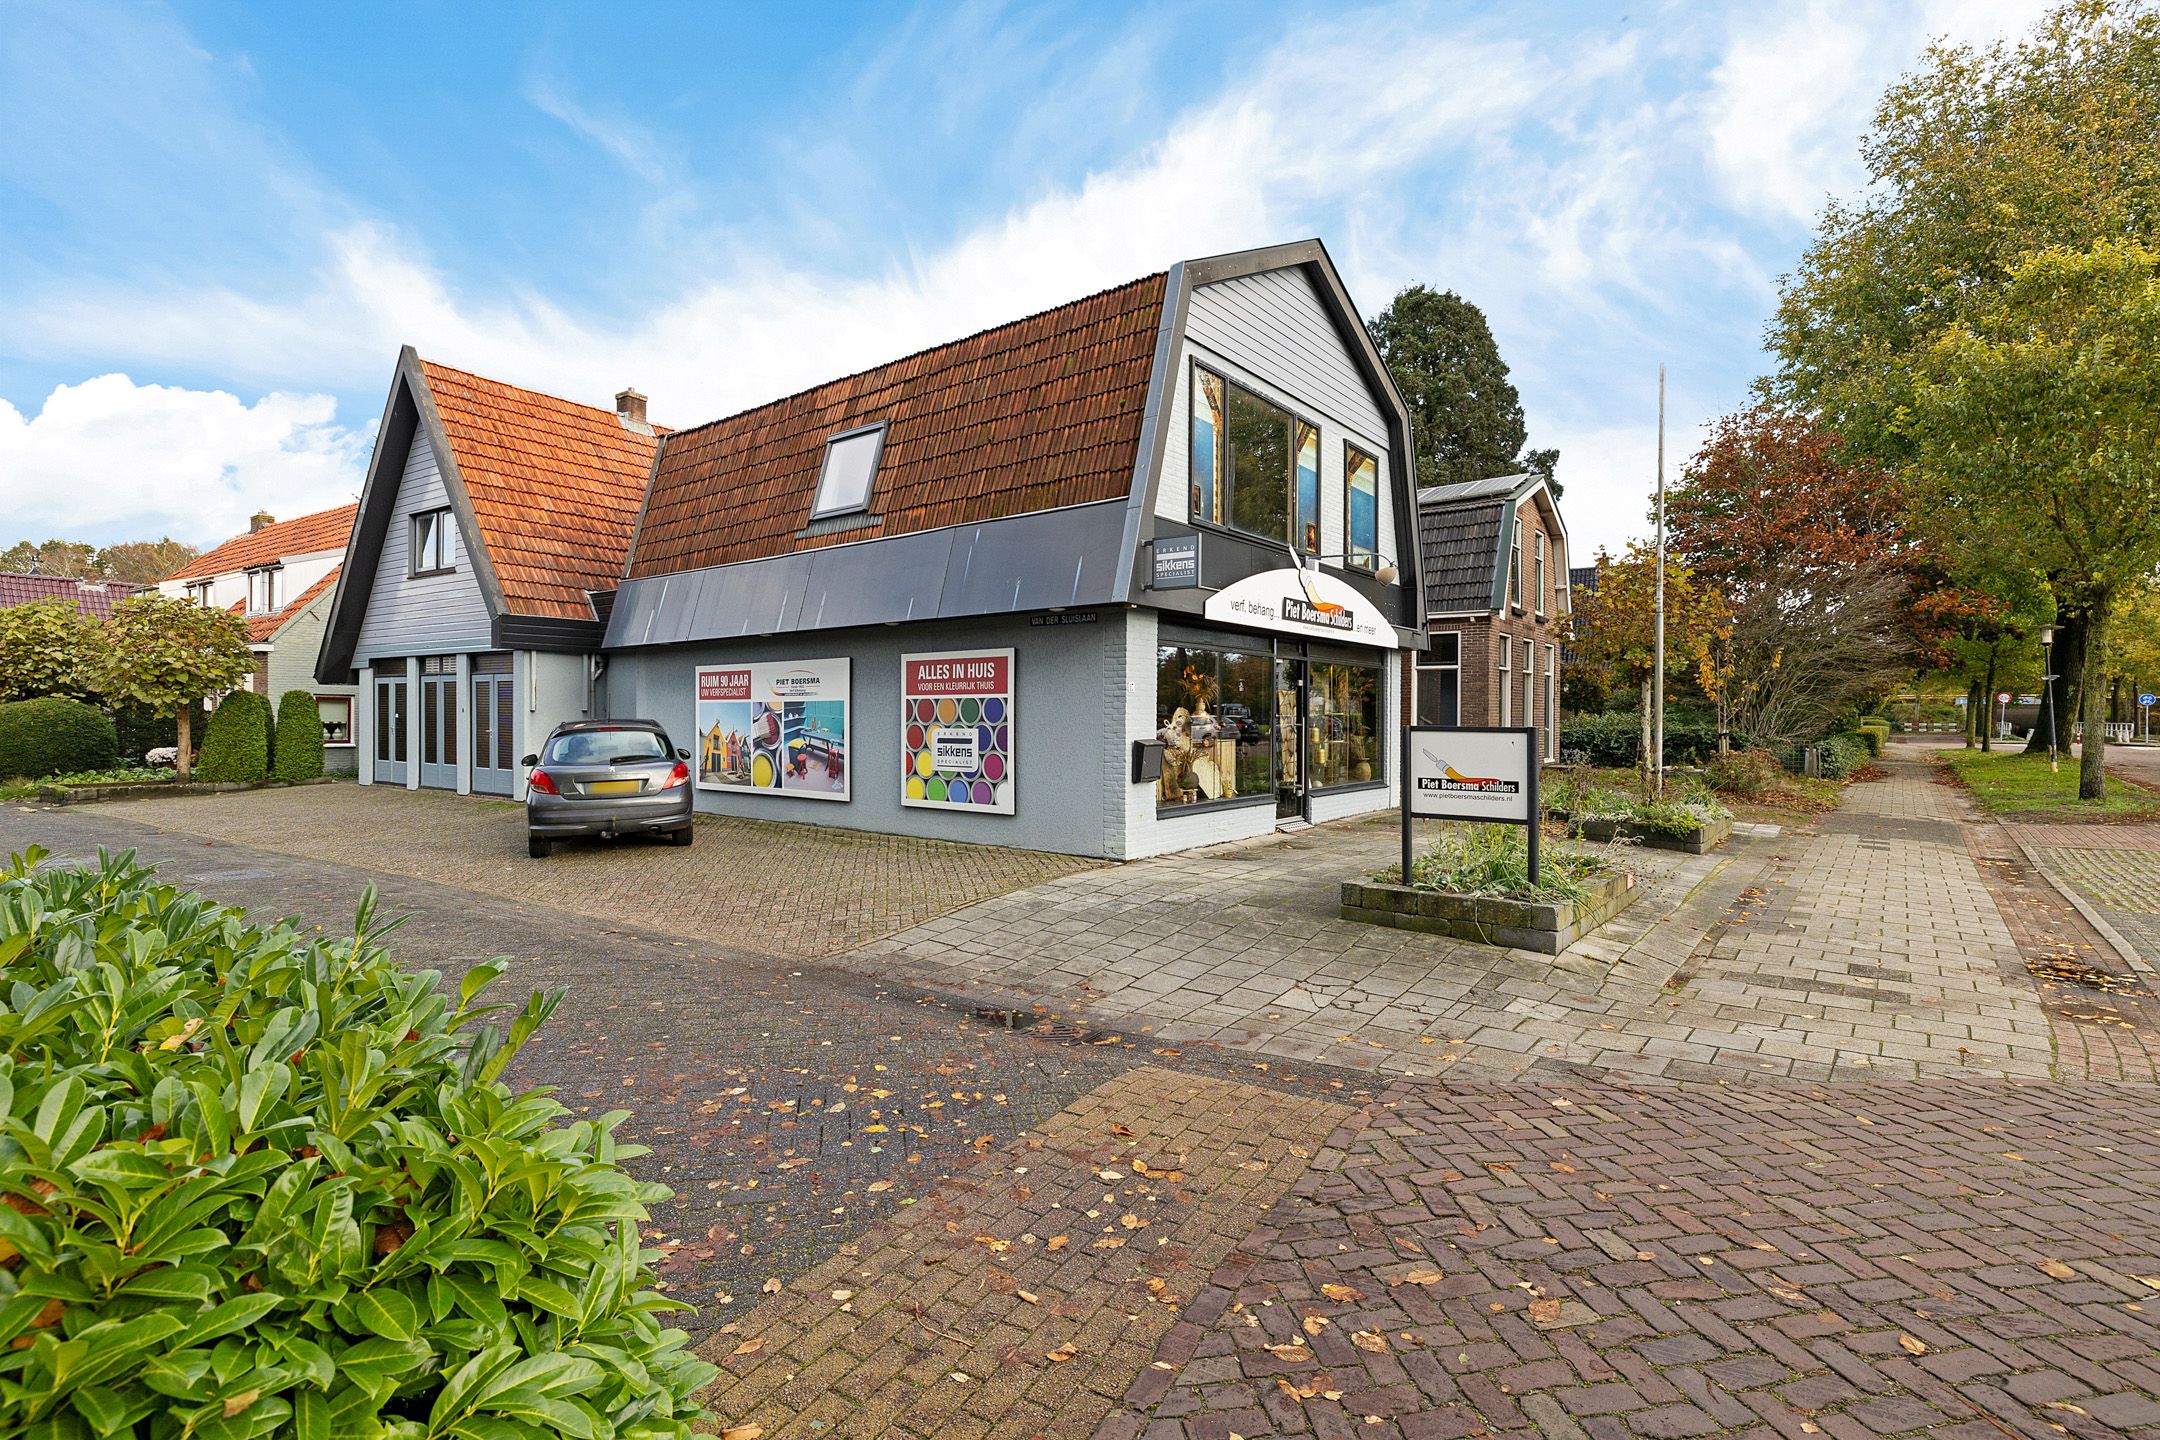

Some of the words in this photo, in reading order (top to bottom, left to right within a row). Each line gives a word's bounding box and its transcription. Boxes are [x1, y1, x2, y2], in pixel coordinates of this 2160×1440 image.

[1156, 545, 1194, 553] ERKEND
[1156, 560, 1194, 571] sikkens
[1230, 599, 1247, 614] verf,
[1031, 617, 1044, 625] VAN
[1046, 615, 1059, 625] DER
[1061, 614, 1096, 624] SLUISLAAN
[1285, 599, 1300, 620] Piet
[1301, 602, 1330, 625] Boersma
[1330, 608, 1353, 629] Schilders
[1364, 625, 1376, 635] meer
[918, 664, 949, 679] ALLES
[953, 663, 964, 678] IN
[967, 662, 995, 678] HUIS
[701, 675, 719, 687] RUIM
[720, 675, 728, 687] 90
[729, 674, 748, 686] JAAR
[918, 682, 933, 691] VOOR
[933, 682, 945, 691] EEN
[945, 681, 975, 690] KLEURRIJK
[976, 680, 995, 690] THUIS
[710, 687, 746, 696] VERFSPECIALIST
[937, 745, 973, 758] sikkens
[1421, 778, 1439, 789] Piet
[1441, 779, 1479, 791] Boersma
[1481, 780, 1516, 793] Schilders
[1423, 792, 1512, 801] www.pietboersmaschilders.nl
